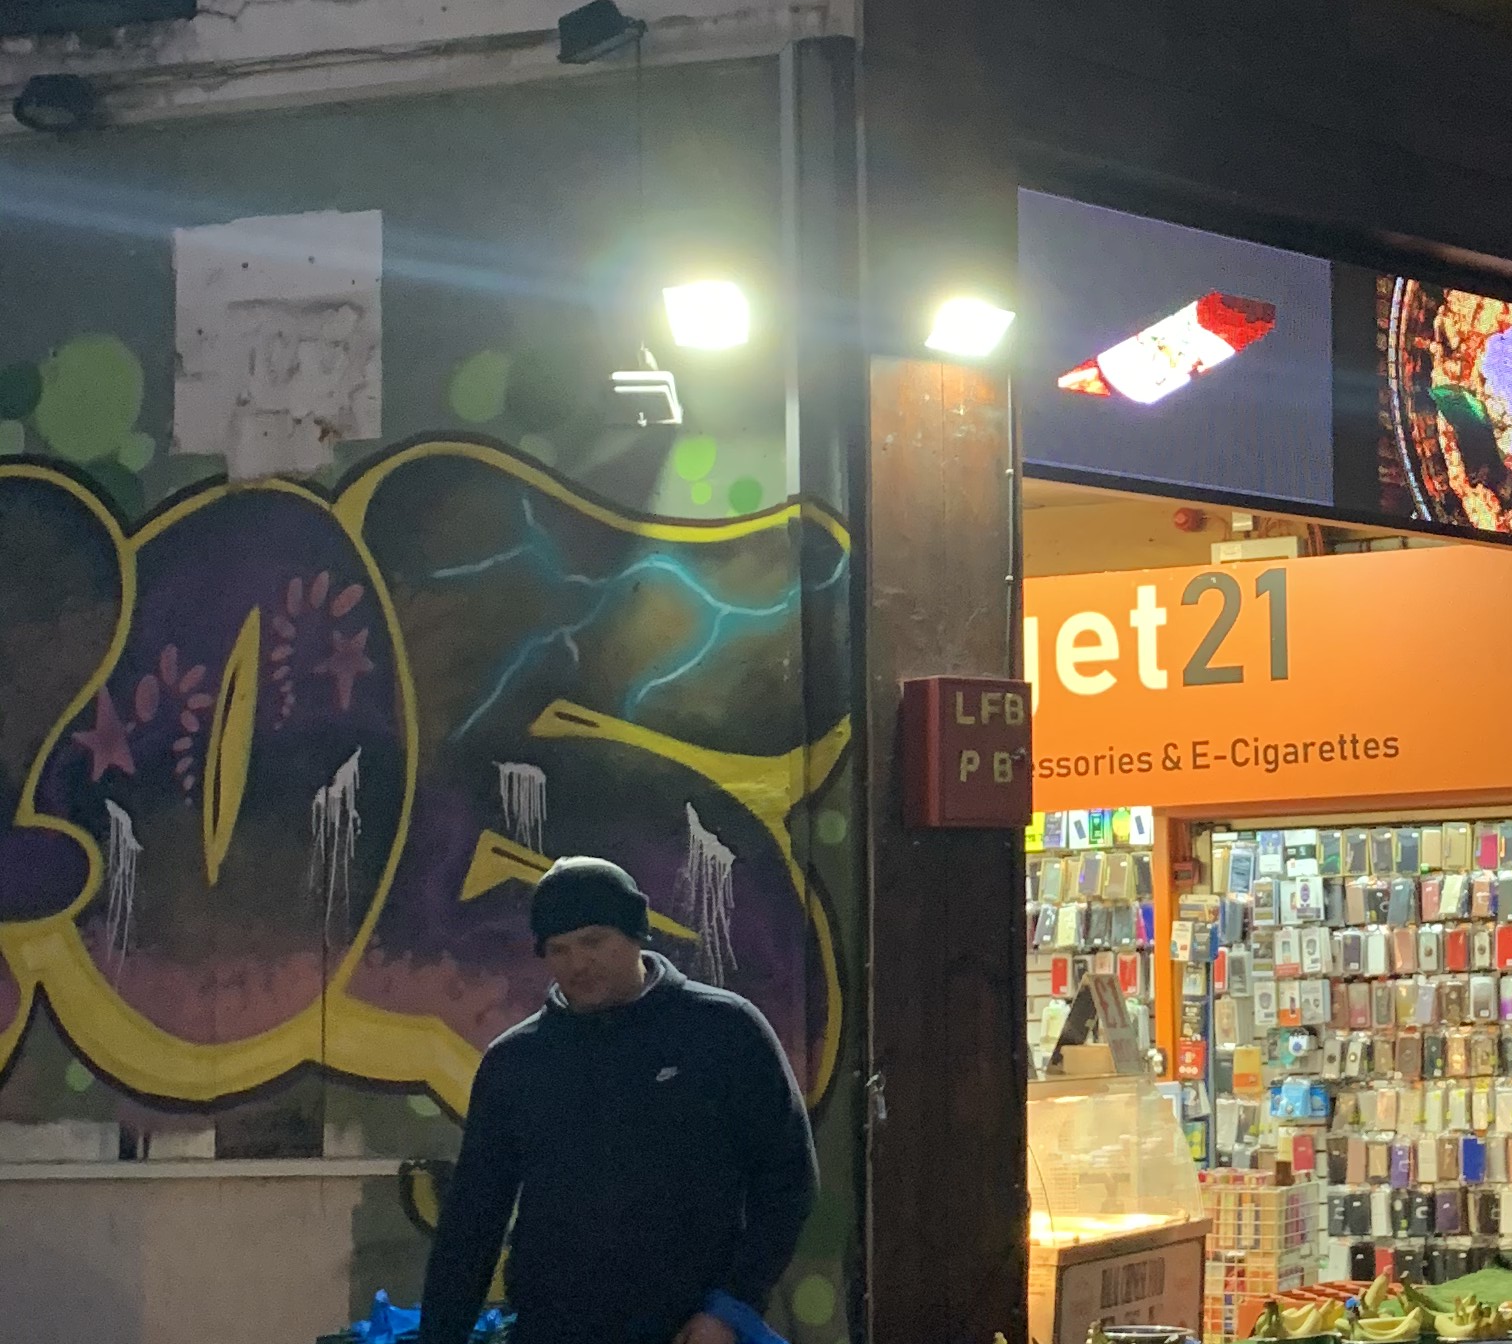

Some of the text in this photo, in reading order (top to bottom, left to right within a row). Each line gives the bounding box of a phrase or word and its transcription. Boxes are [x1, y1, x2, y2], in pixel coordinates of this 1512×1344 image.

[955, 691, 1025, 726] LFB
[1031, 733, 1400, 779] ssories & E-Cigarettes
